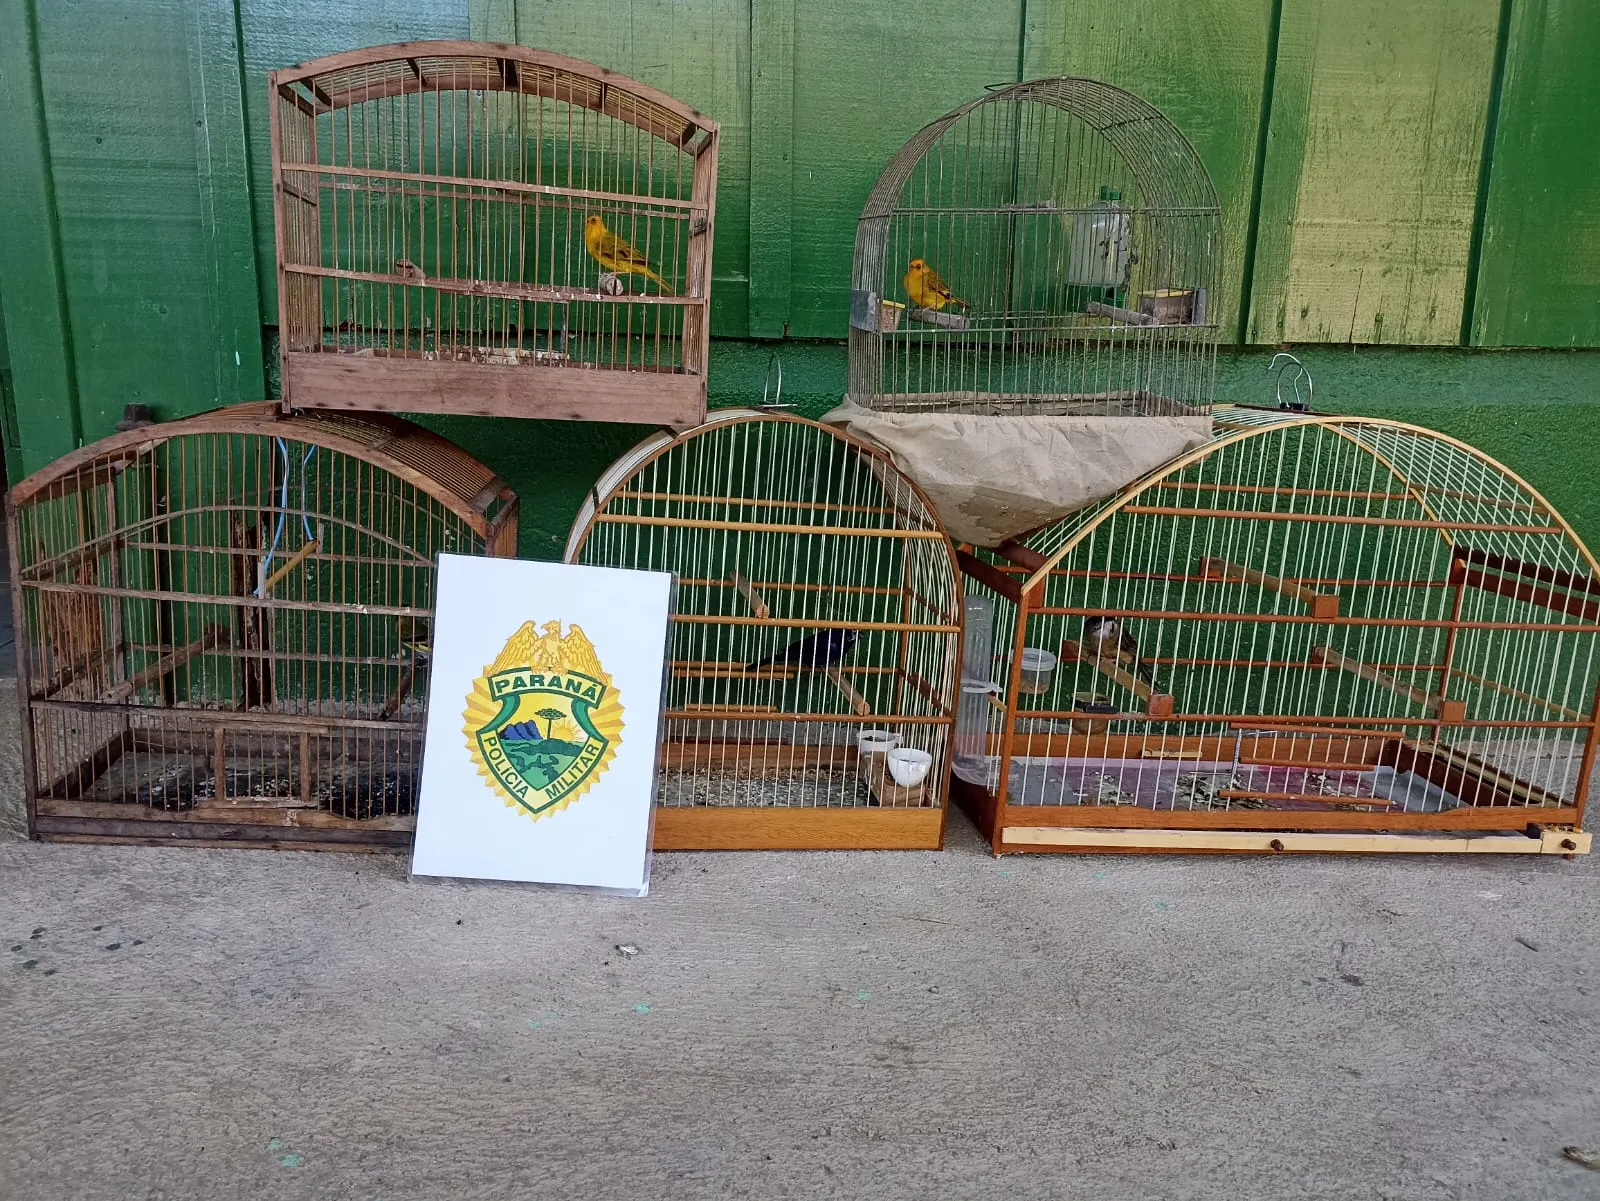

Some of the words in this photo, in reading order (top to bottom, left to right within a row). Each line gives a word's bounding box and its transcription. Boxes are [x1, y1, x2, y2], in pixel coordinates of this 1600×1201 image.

[495, 674, 596, 701] PARANÁ
[483, 736, 528, 799] POLÍCIA
[544, 744, 599, 800] MILITAR
